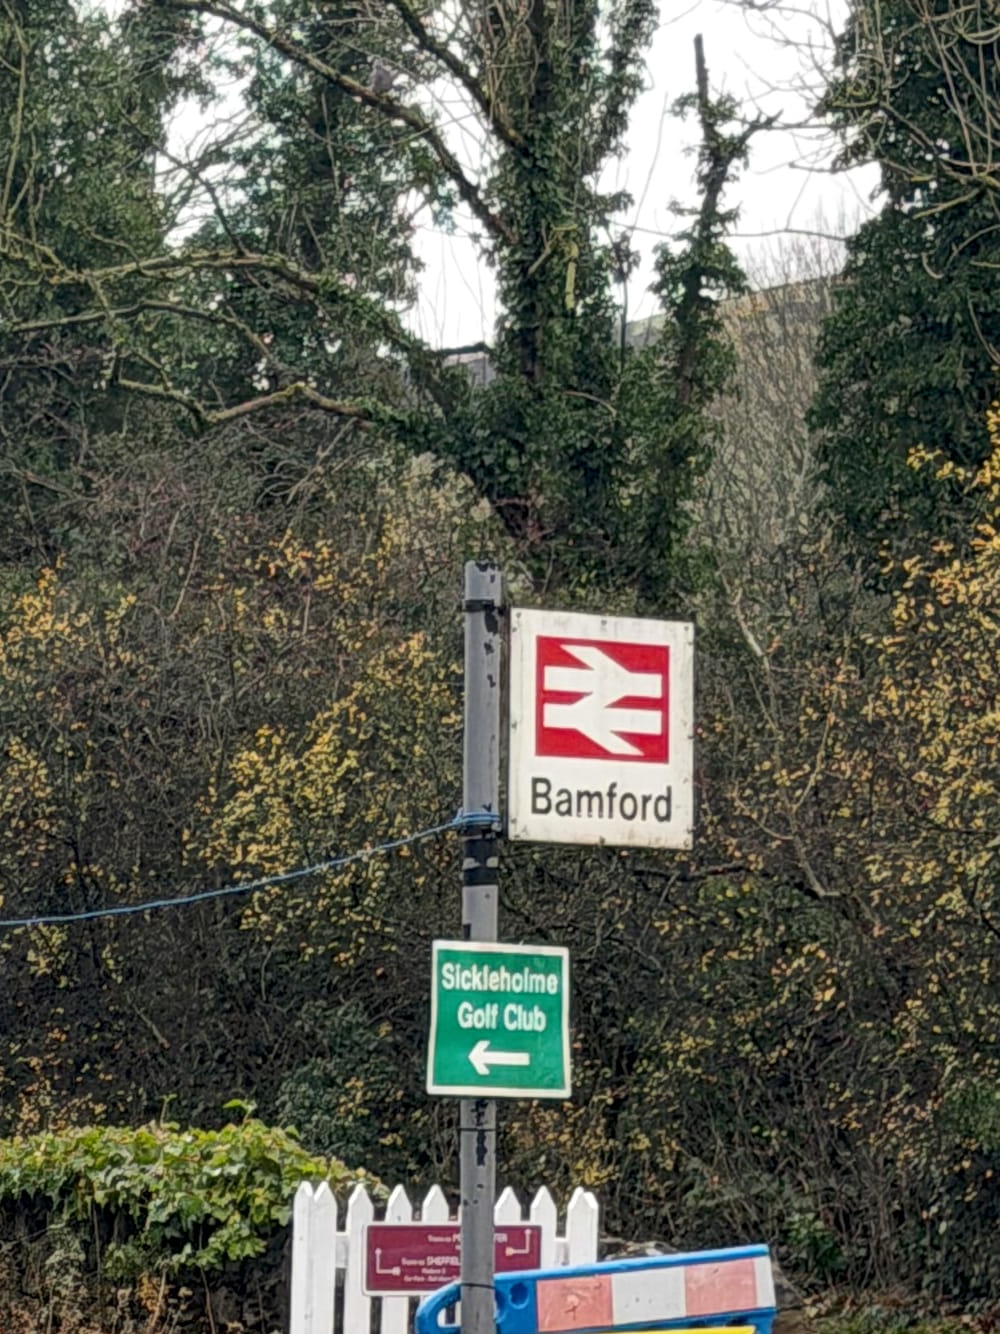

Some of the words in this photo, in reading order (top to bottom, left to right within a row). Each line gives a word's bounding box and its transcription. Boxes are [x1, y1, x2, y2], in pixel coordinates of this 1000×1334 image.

[531, 777, 673, 823] Bamford
[441, 962, 559, 995] Sickleholme
[457, 1002, 499, 1030] Golf
[503, 1004, 547, 1033] Club
